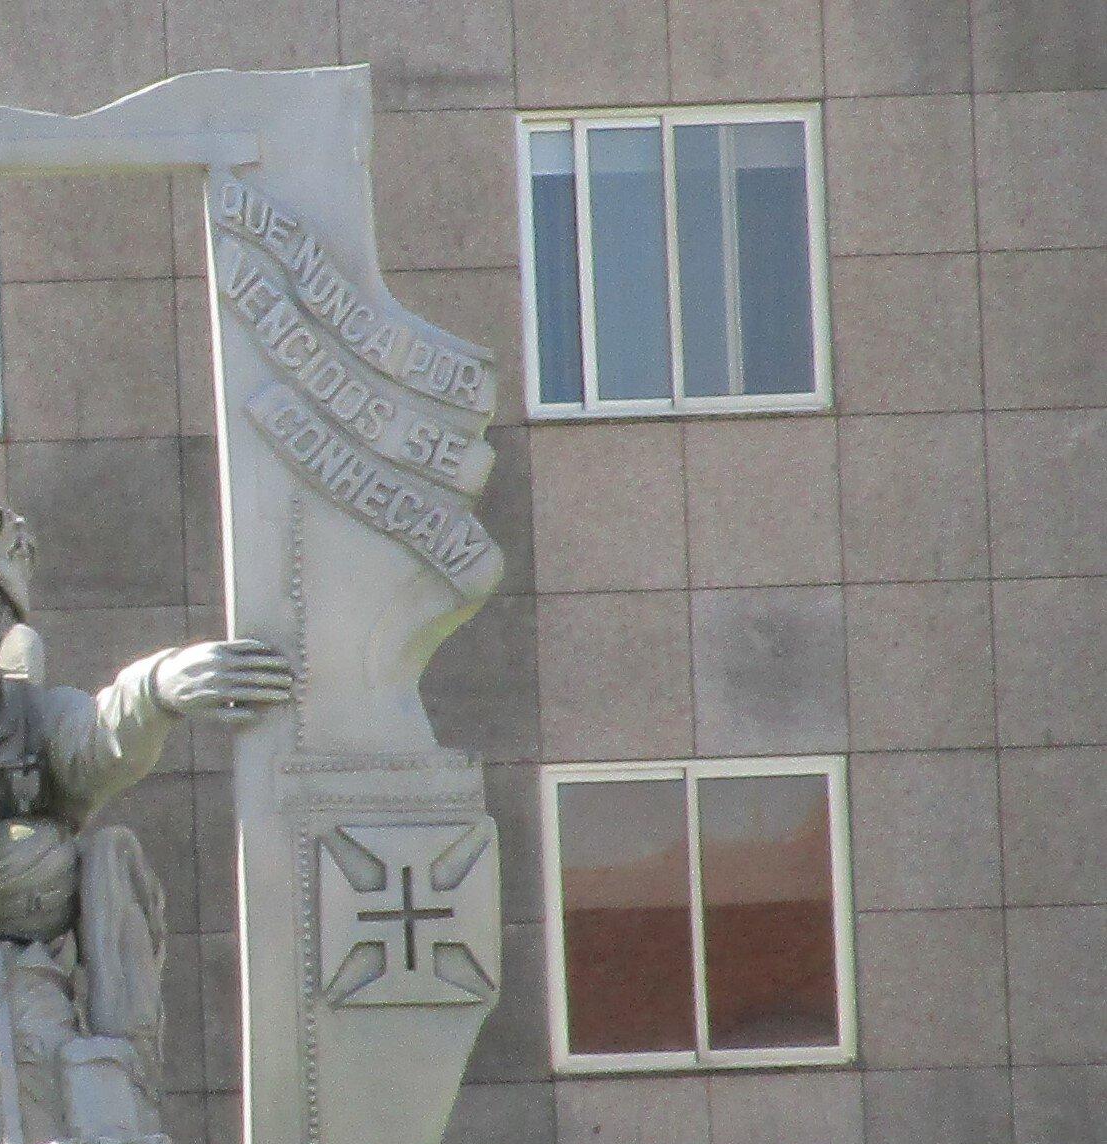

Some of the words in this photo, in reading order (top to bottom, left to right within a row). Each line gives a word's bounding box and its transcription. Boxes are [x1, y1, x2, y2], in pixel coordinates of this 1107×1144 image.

[219, 181, 298, 247] QUE
[292, 237, 396, 358] NUNCA
[407, 338, 485, 412] POR
[228, 250, 396, 443] VENCIDOS
[404, 419, 470, 478] SE
